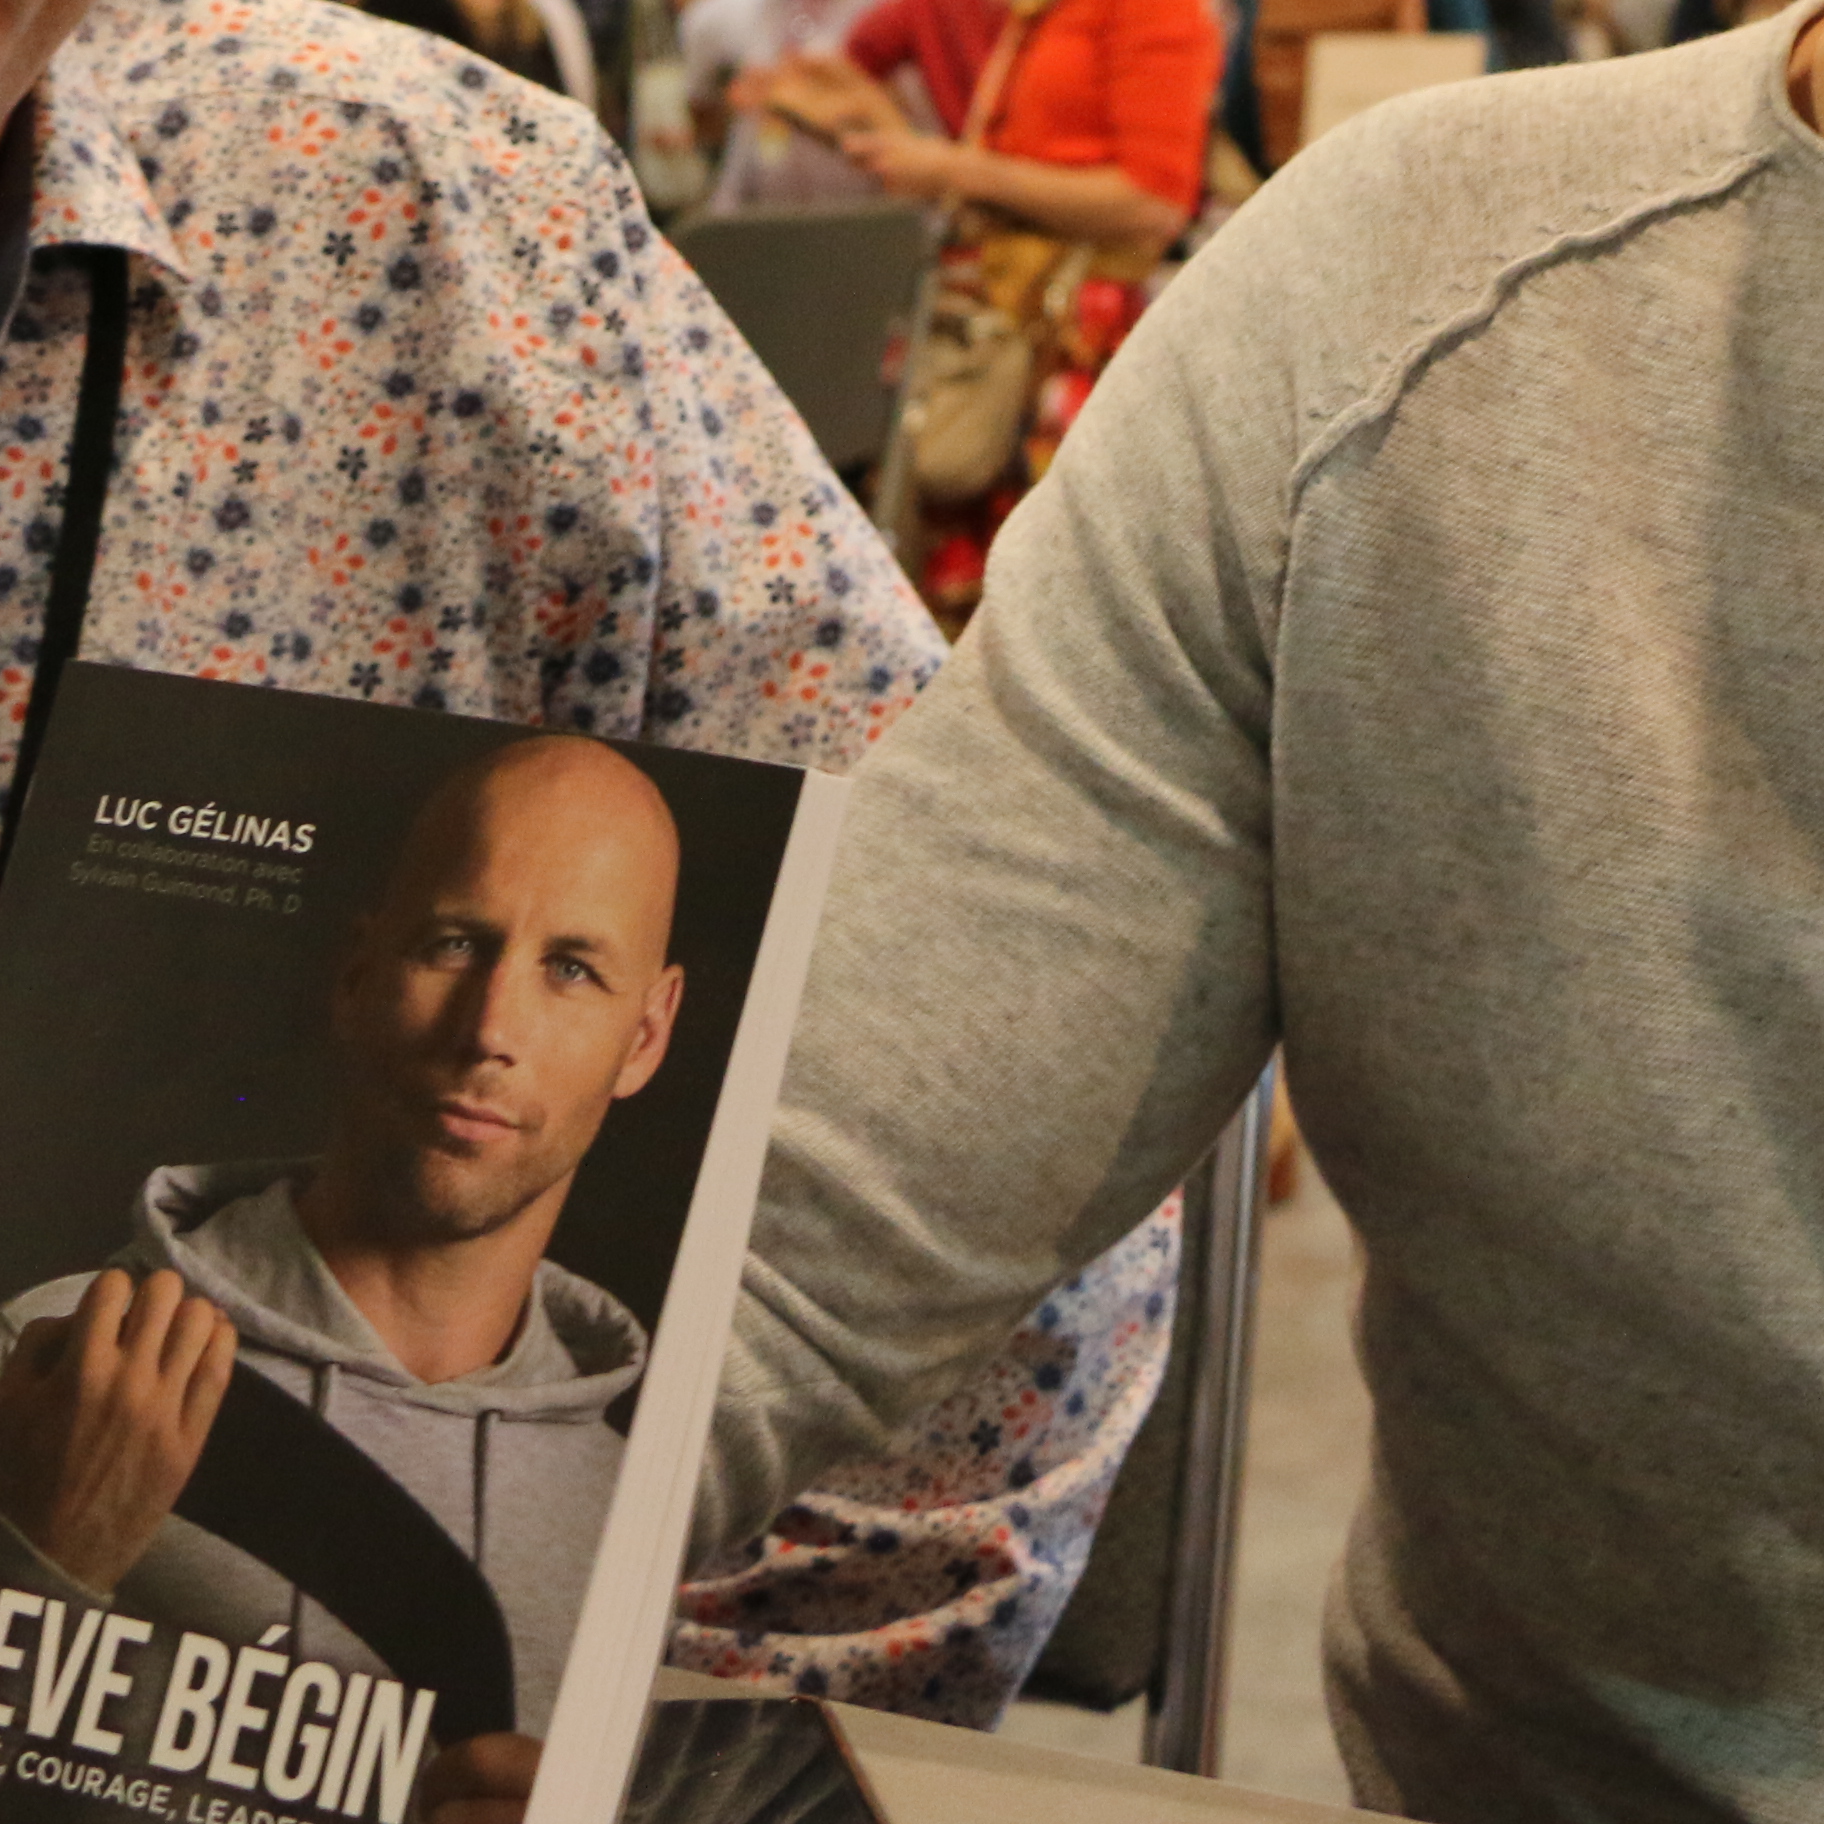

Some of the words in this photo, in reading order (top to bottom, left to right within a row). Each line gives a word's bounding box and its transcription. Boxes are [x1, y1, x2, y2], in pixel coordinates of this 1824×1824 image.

[94, 794, 163, 831] LUC
[168, 801, 316, 853] GÉLINAS
[69, 861, 139, 887] Sylvain
[87, 832, 114, 854] En
[117, 838, 250, 874] collaboration
[253, 861, 303, 884] avec
[149, 1624, 437, 1824] BÉGIN
[17, 1750, 178, 1822] COURAGE,
